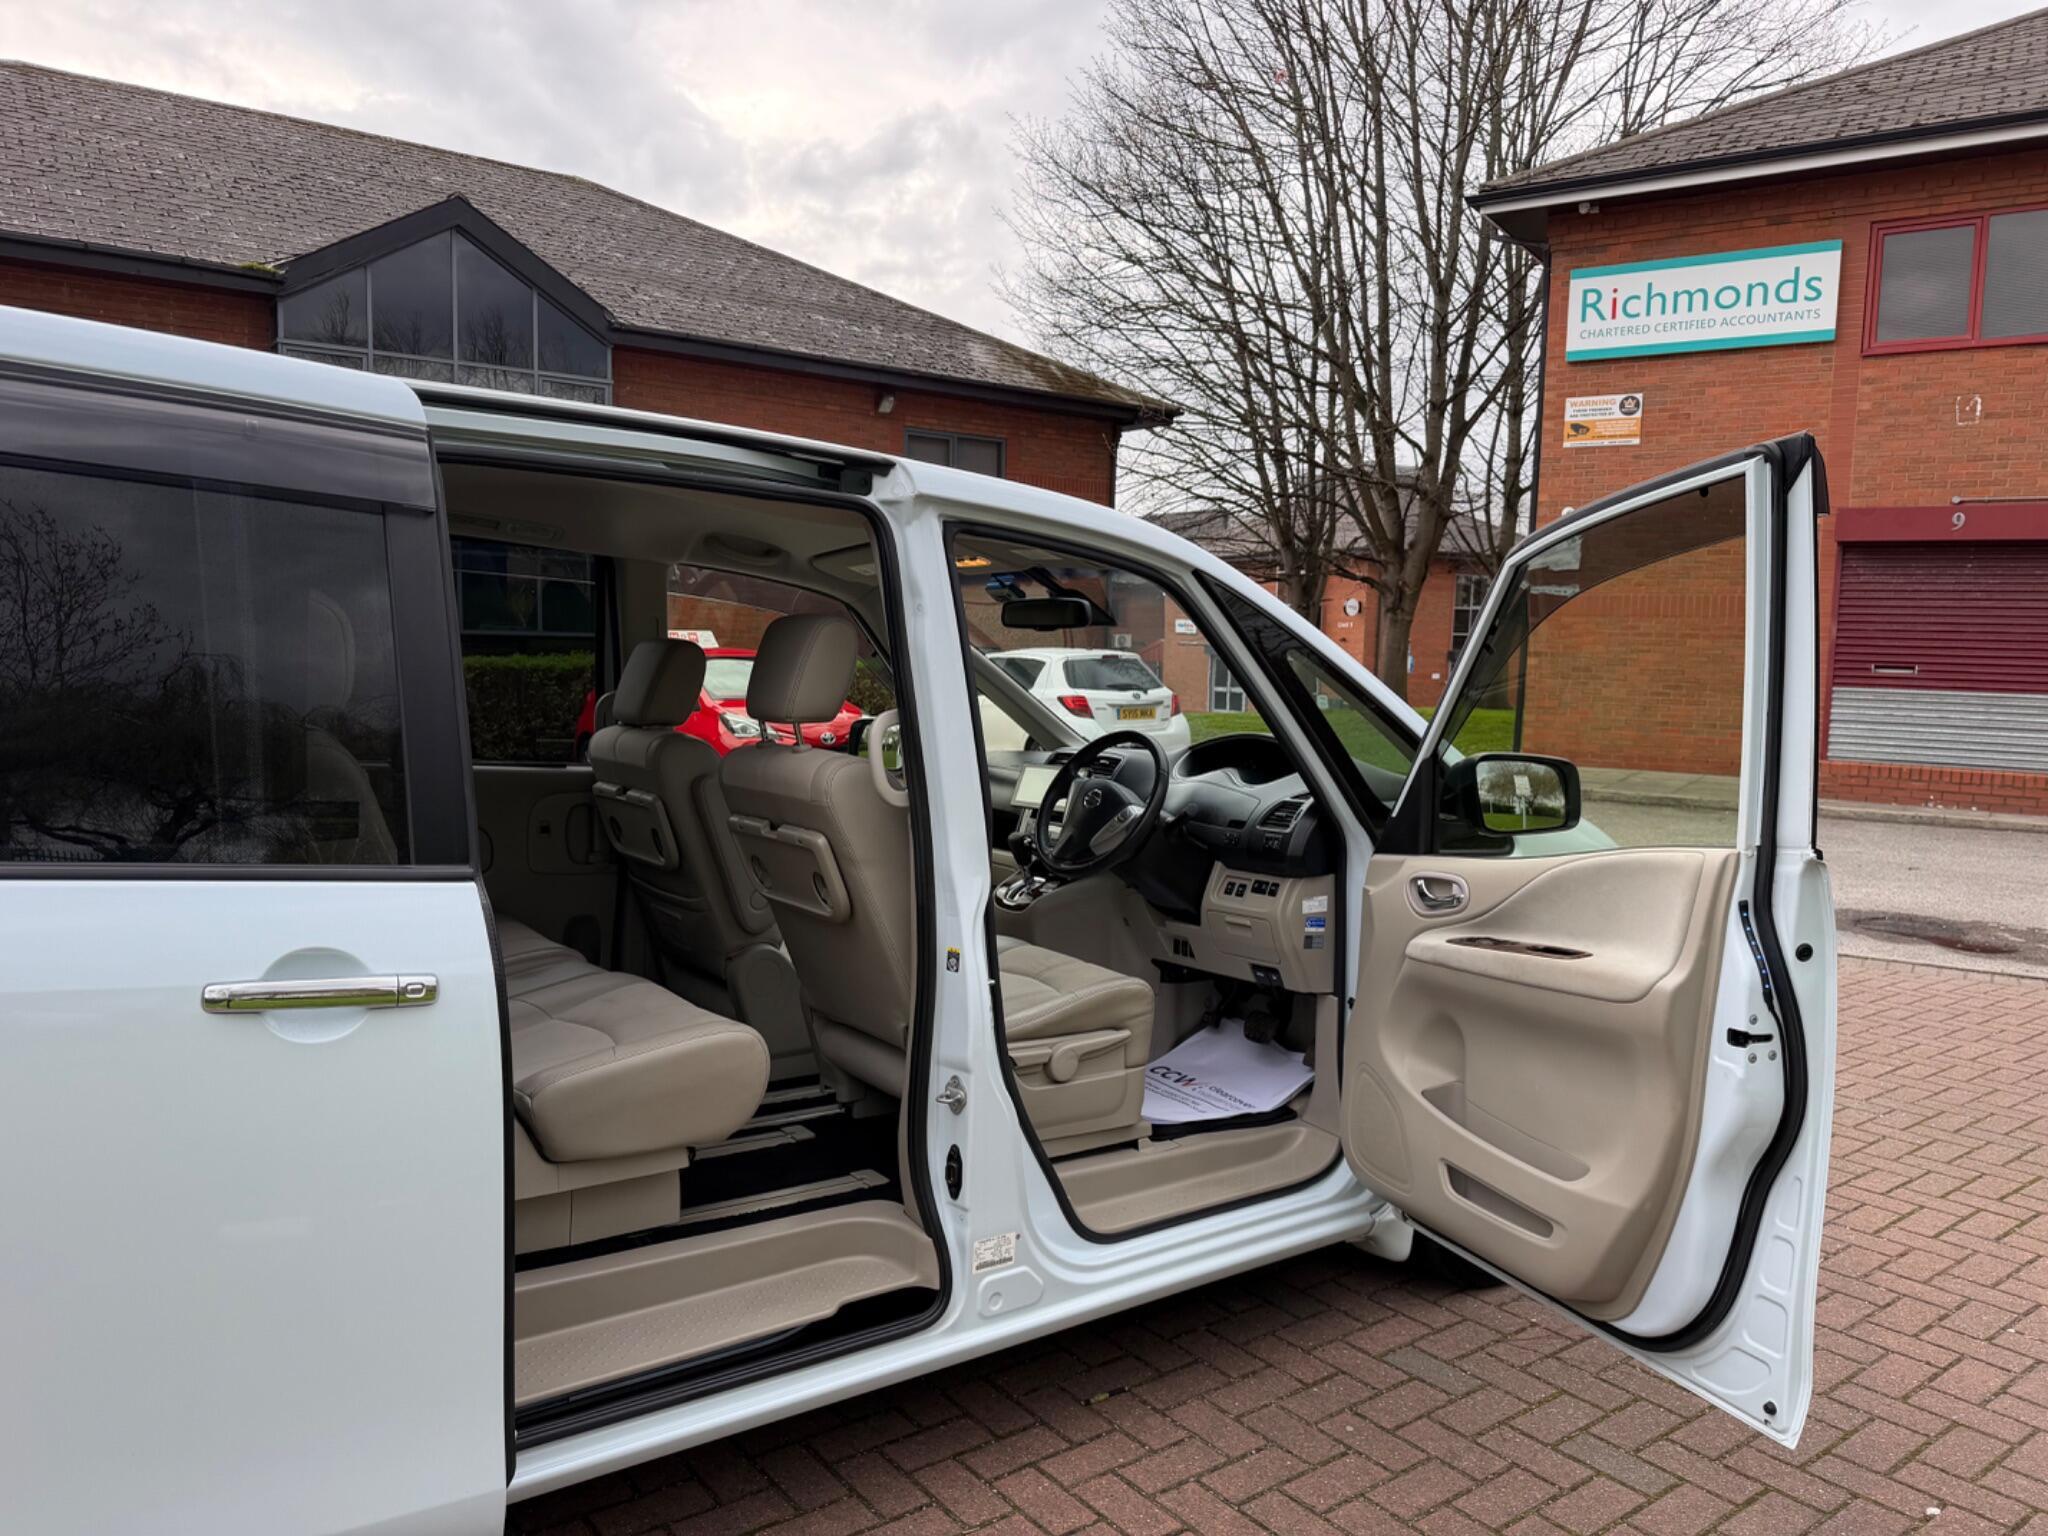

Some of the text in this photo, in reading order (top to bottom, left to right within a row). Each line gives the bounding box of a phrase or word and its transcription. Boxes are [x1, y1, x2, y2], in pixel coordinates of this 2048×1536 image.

[1580, 266, 1823, 323] Richmonds
[1579, 308, 1822, 340] CHARTERED CERTIFIED ACCOUNTANTS
[1570, 398, 1616, 408] WARNING
[1951, 511, 1966, 531] 9
